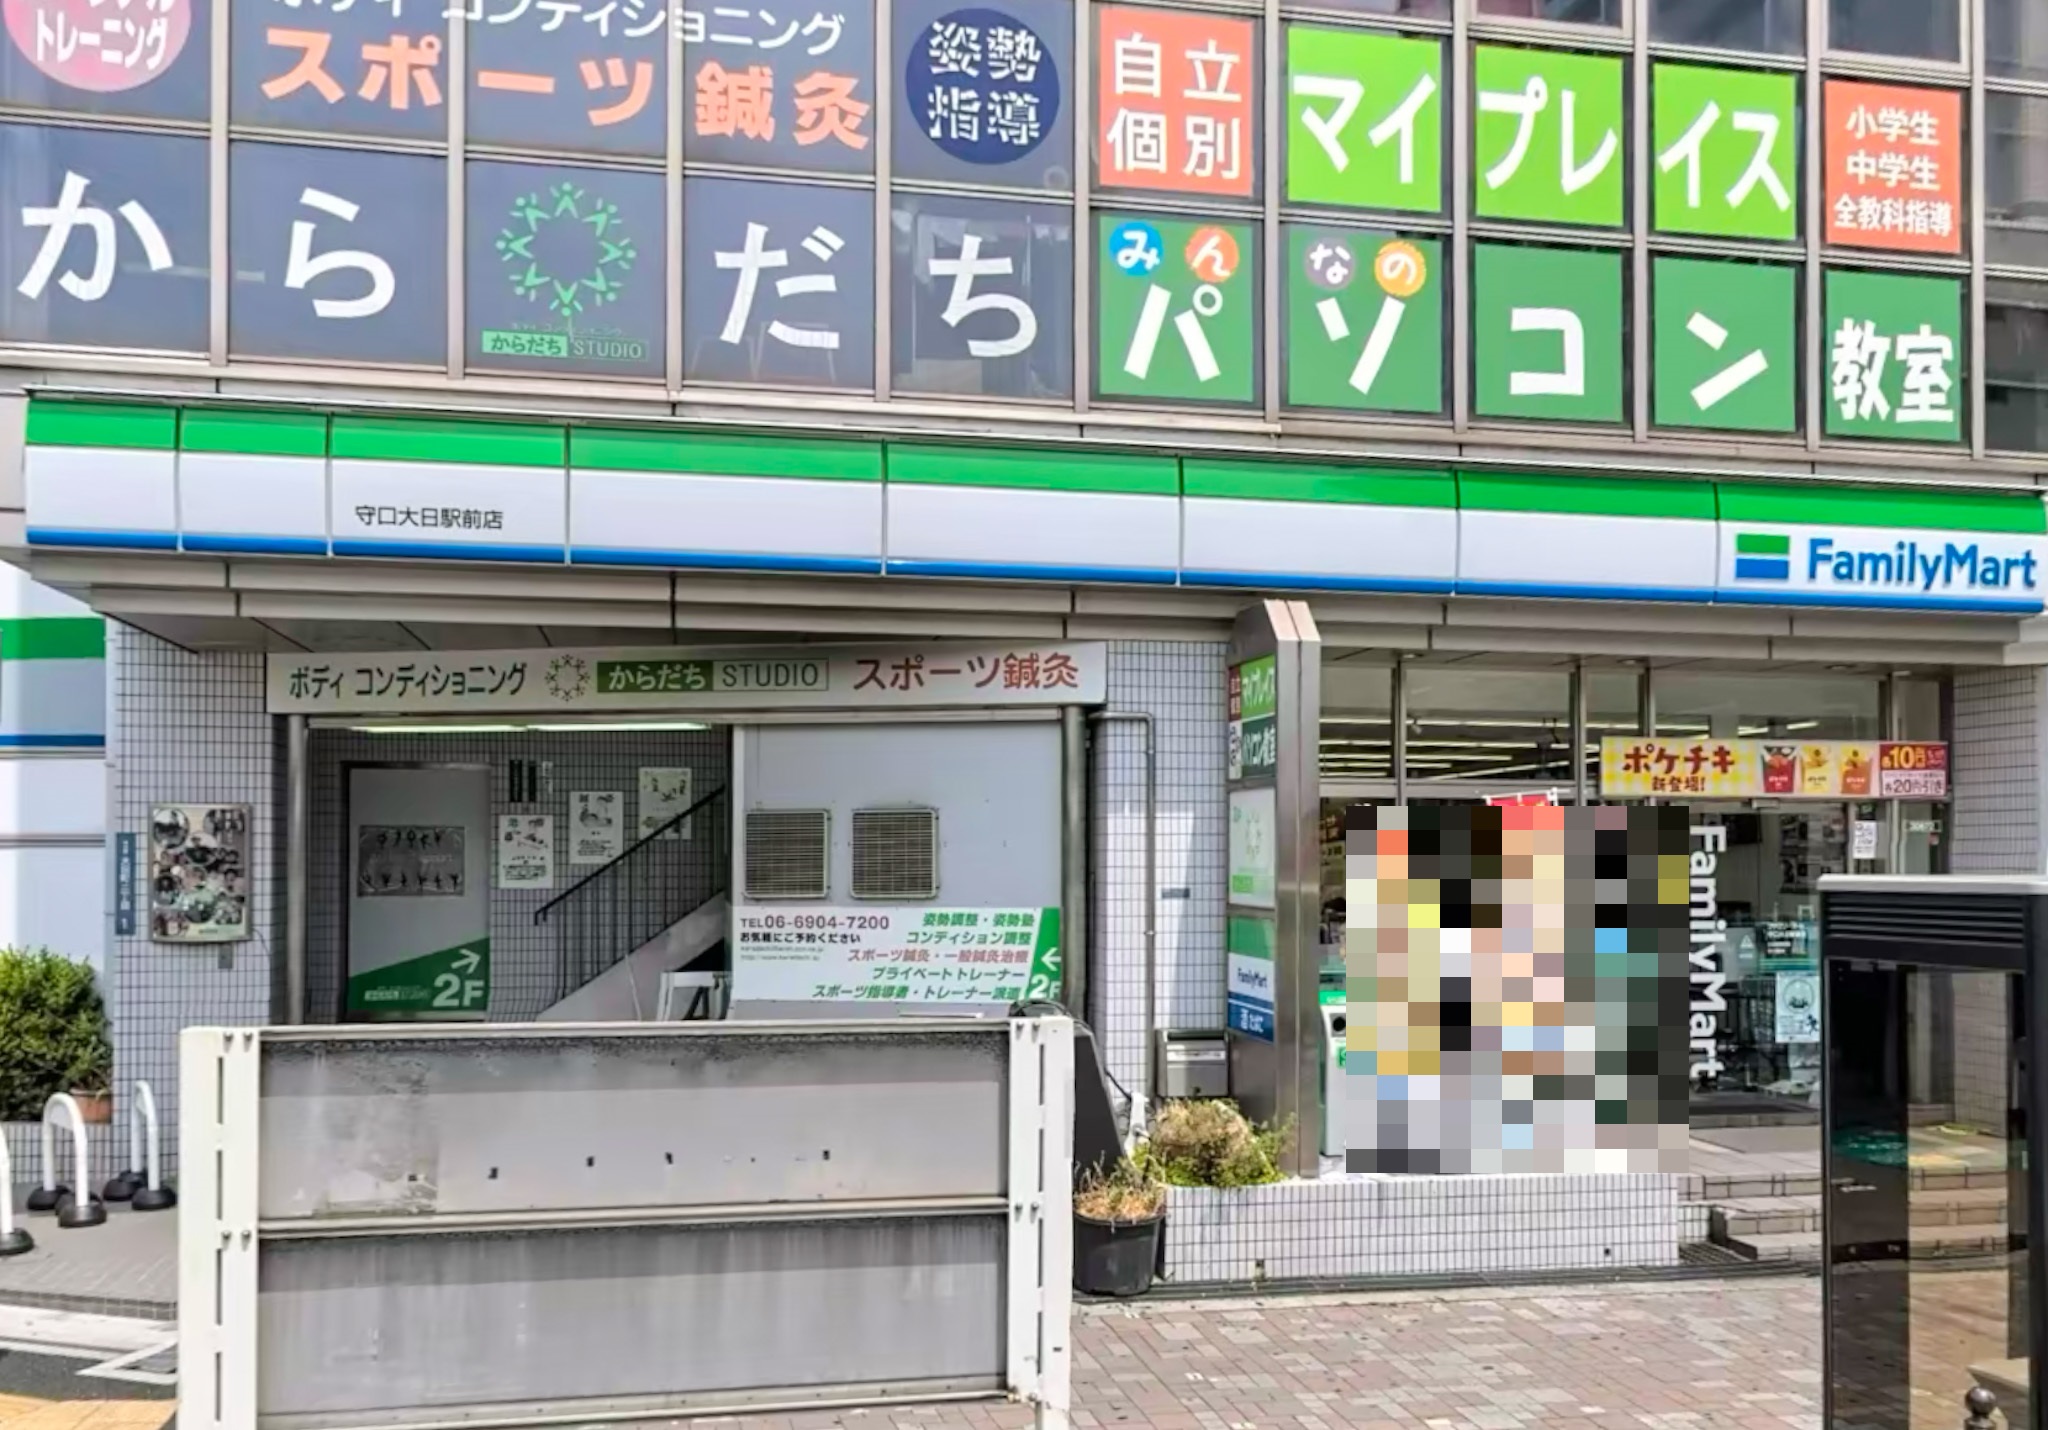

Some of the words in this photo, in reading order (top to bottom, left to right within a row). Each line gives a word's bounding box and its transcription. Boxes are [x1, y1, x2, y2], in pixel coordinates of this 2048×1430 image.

[37, 8, 168, 70] トレーニング
[928, 20, 1041, 83] 姿勢
[262, 27, 868, 149] スポーツ鍼灸
[1113, 32, 1241, 103] 自立
[927, 87, 1040, 146] 指導
[1845, 104, 1940, 145] 小学生
[1107, 108, 1241, 180] 個別
[1292, 74, 1791, 212] マイプレイス
[1845, 148, 1941, 191] 中学生
[1834, 193, 1953, 237] 全教科指導
[492, 334, 562, 356] からだち
[573, 339, 642, 359] STUDIO
[355, 504, 503, 530] 守口大日駅前店
[1808, 537, 2037, 590] FamilyMart
[289, 666, 344, 698] ボディ
[355, 662, 528, 698] コンディショニング
[608, 662, 707, 691] からだち
[723, 662, 818, 688] STUDIO
[853, 652, 1079, 691] スポーツ鍼灸
[1622, 743, 1735, 774] ポケチキ
[1689, 825, 1727, 1079] FamilyMart
[432, 972, 485, 1007] 2F
[1030, 974, 1061, 1001] 2F
